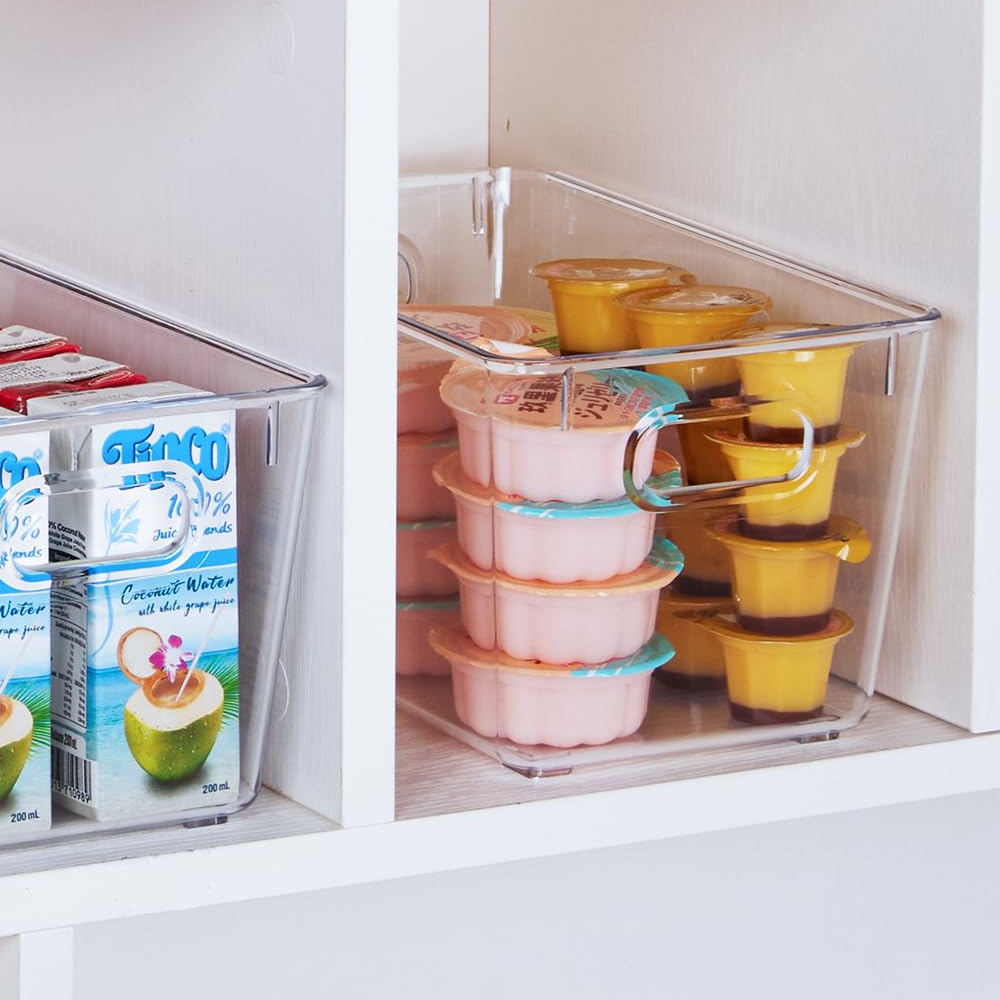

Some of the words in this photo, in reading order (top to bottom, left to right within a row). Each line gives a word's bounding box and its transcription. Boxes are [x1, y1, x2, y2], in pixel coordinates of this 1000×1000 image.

[153, 528, 178, 541] Juic
[120, 578, 185, 605] Coconut
[186, 573, 235, 593] Water
[185, 600, 211, 617] grape
[212, 597, 235, 614] juice
[22, 624, 47, 640] juice
[202, 783, 218, 794] 200
[218, 780, 230, 791] mL
[10, 812, 26, 823] 200
[27, 809, 40, 820] mL
